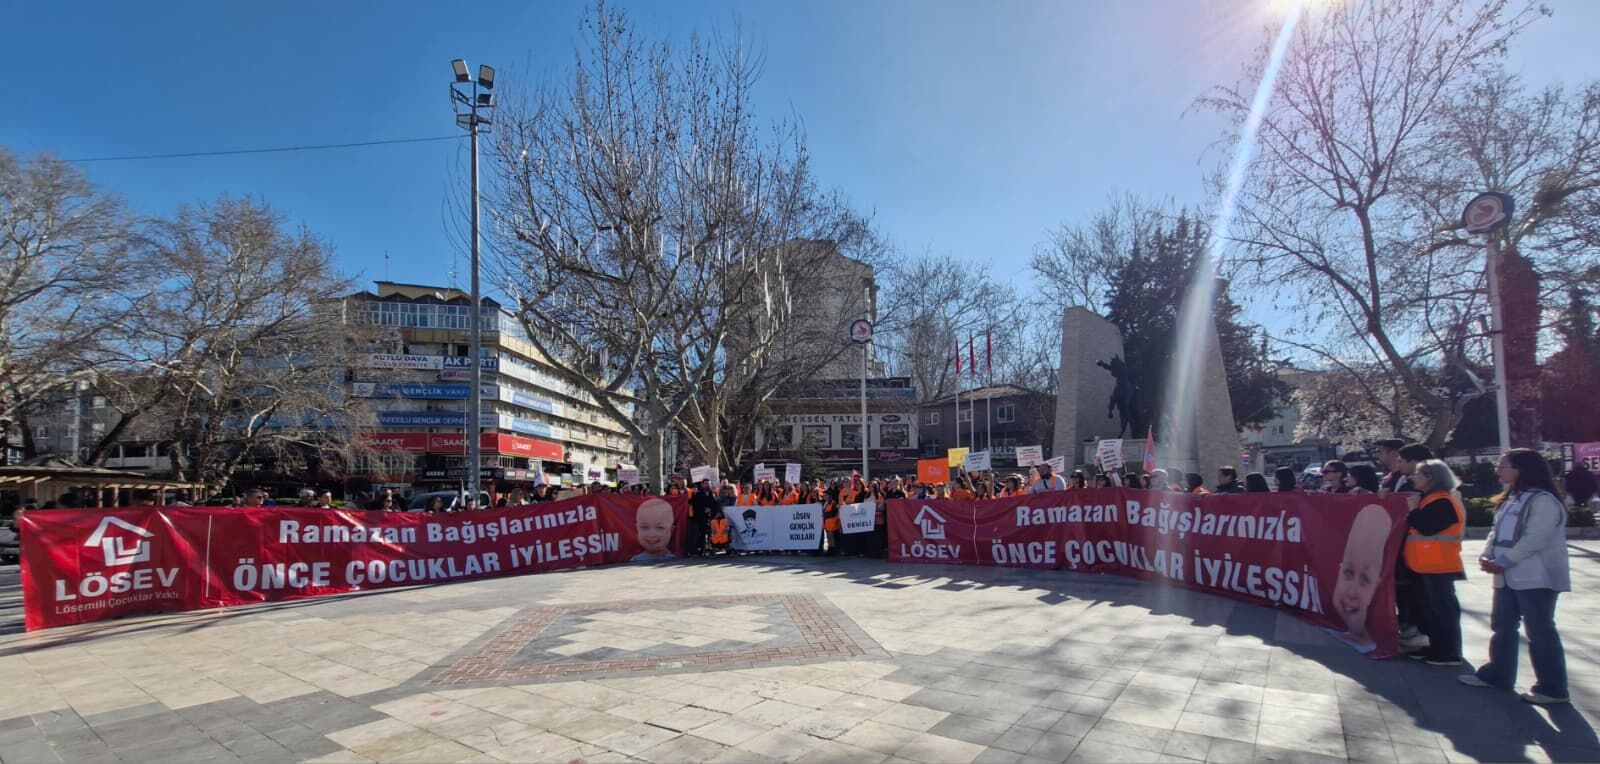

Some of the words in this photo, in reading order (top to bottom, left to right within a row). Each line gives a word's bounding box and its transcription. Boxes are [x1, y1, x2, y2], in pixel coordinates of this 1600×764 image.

[445, 357, 461, 366] AK
[464, 357, 497, 367] PRTİ
[403, 387, 443, 396] GENÇLİK
[368, 438, 404, 446] SAADET
[793, 511, 811, 520] LÖSEV
[1016, 504, 1118, 527] Ramazan
[1126, 500, 1302, 543] Bağışlarınızla
[279, 520, 416, 544] Ramazan
[427, 505, 597, 545] Bağışlarınızla
[789, 523, 815, 532] GENÇLİK
[847, 520, 872, 529] DENİZLİ
[789, 533, 815, 541] KOLLARI
[901, 540, 961, 559] LÖSEV
[233, 557, 331, 592] ÖNCE
[345, 552, 501, 591] ÇOCUKLAR
[510, 529, 620, 568] İYİLEŞSİN
[991, 539, 1057, 564] ÖNCE
[1065, 539, 1185, 581] ÇOCUKLAR
[1194, 549, 1324, 615] İYİLEŞSİN
[55, 567, 180, 602] LÖSEV
[55, 599, 106, 615] Lösemili
[107, 593, 153, 608] Çocuklar
